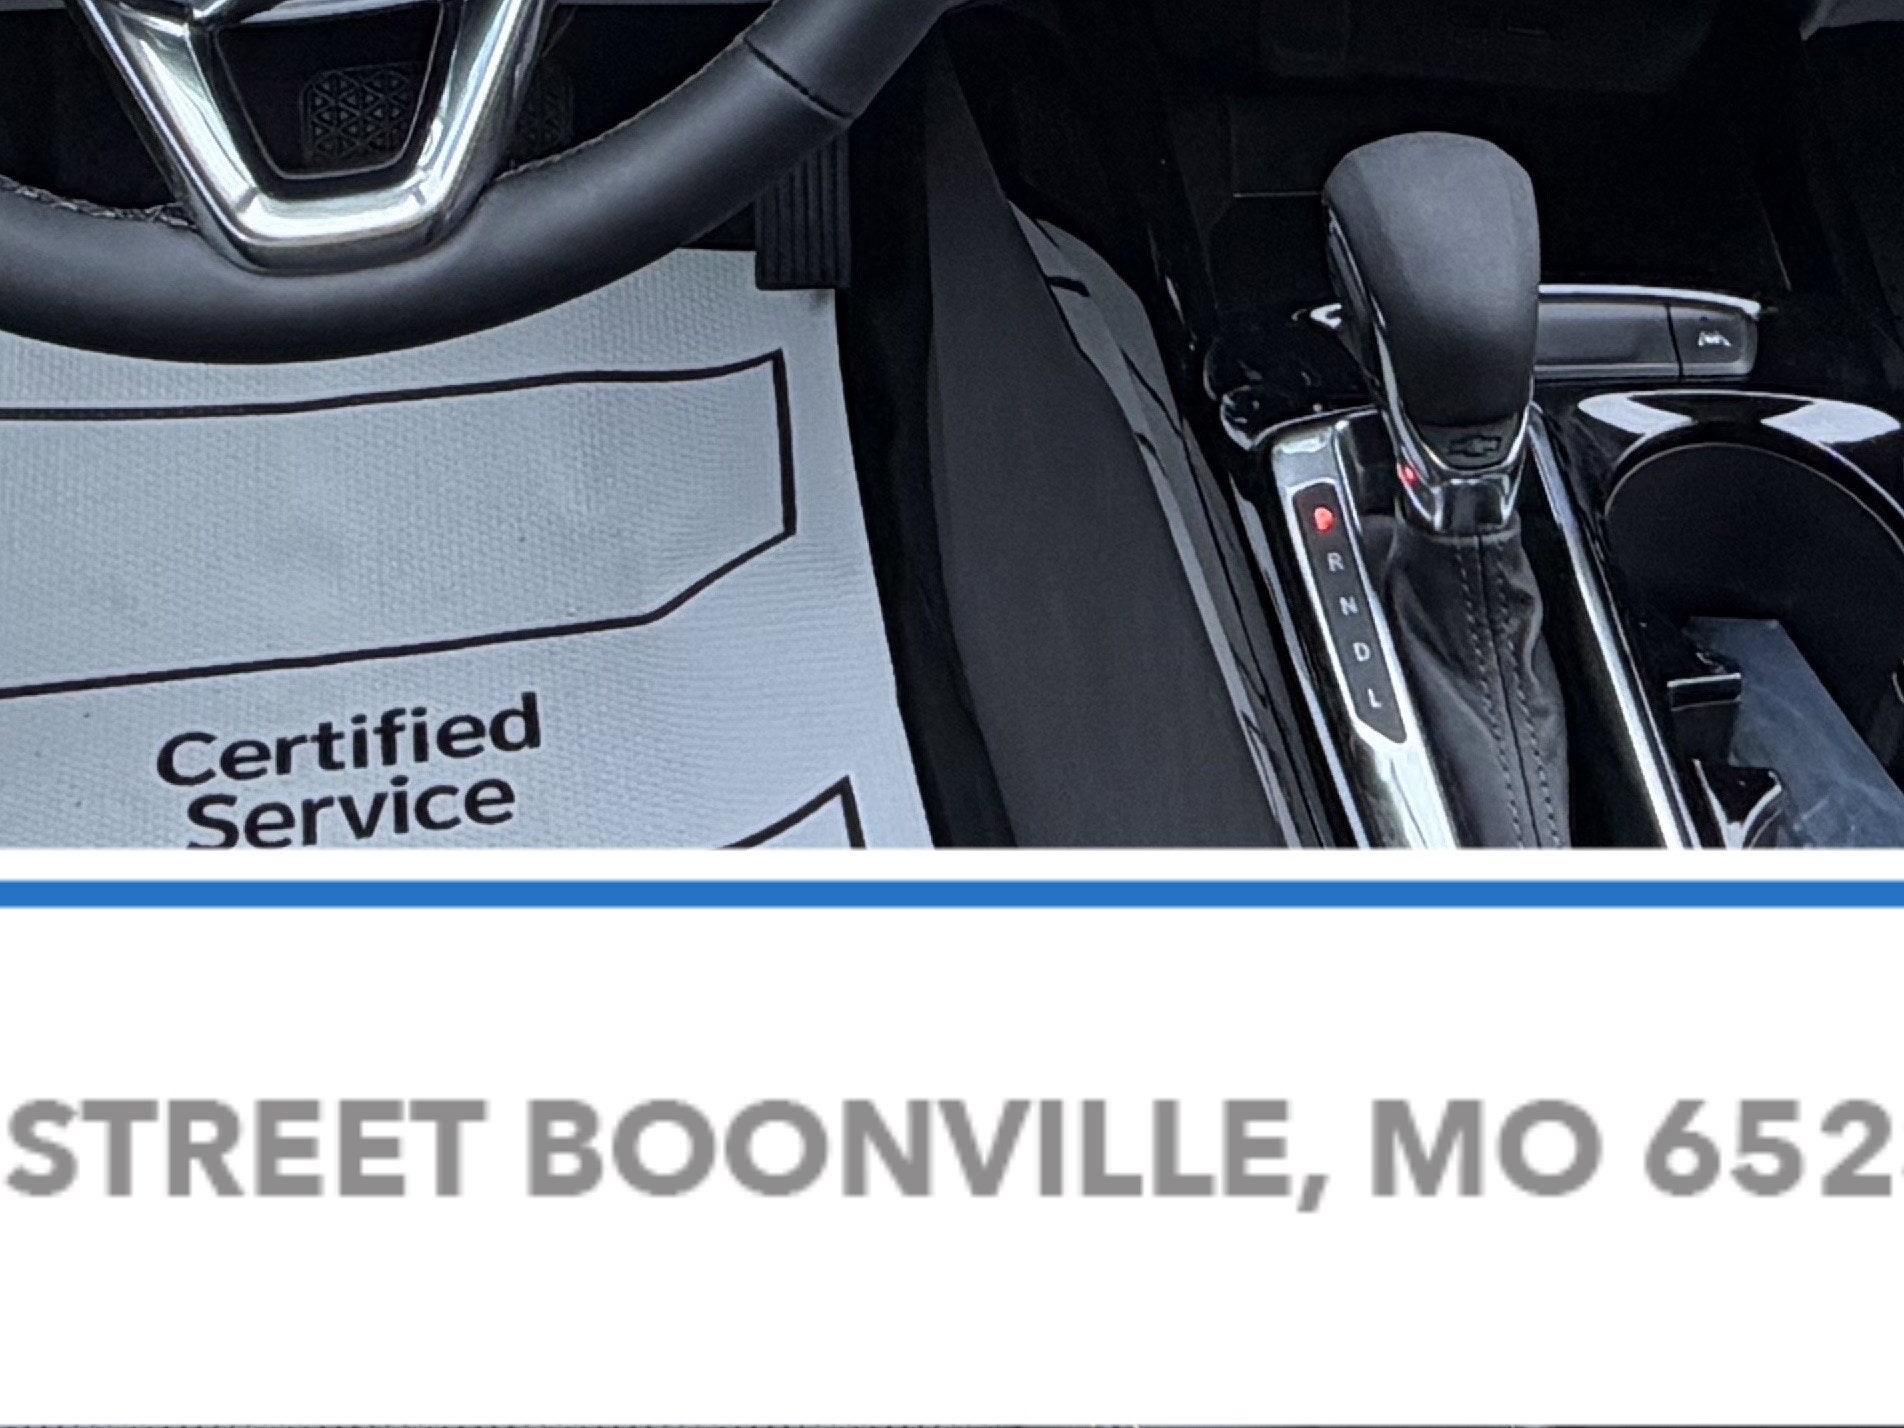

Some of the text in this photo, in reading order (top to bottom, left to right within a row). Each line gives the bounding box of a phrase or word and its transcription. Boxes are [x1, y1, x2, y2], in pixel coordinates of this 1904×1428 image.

[1327, 551, 1344, 573] R
[1340, 595, 1358, 617] N
[1354, 641, 1371, 662] D
[1366, 688, 1382, 710] L
[154, 689, 543, 787] Certified
[185, 774, 516, 849] Service
